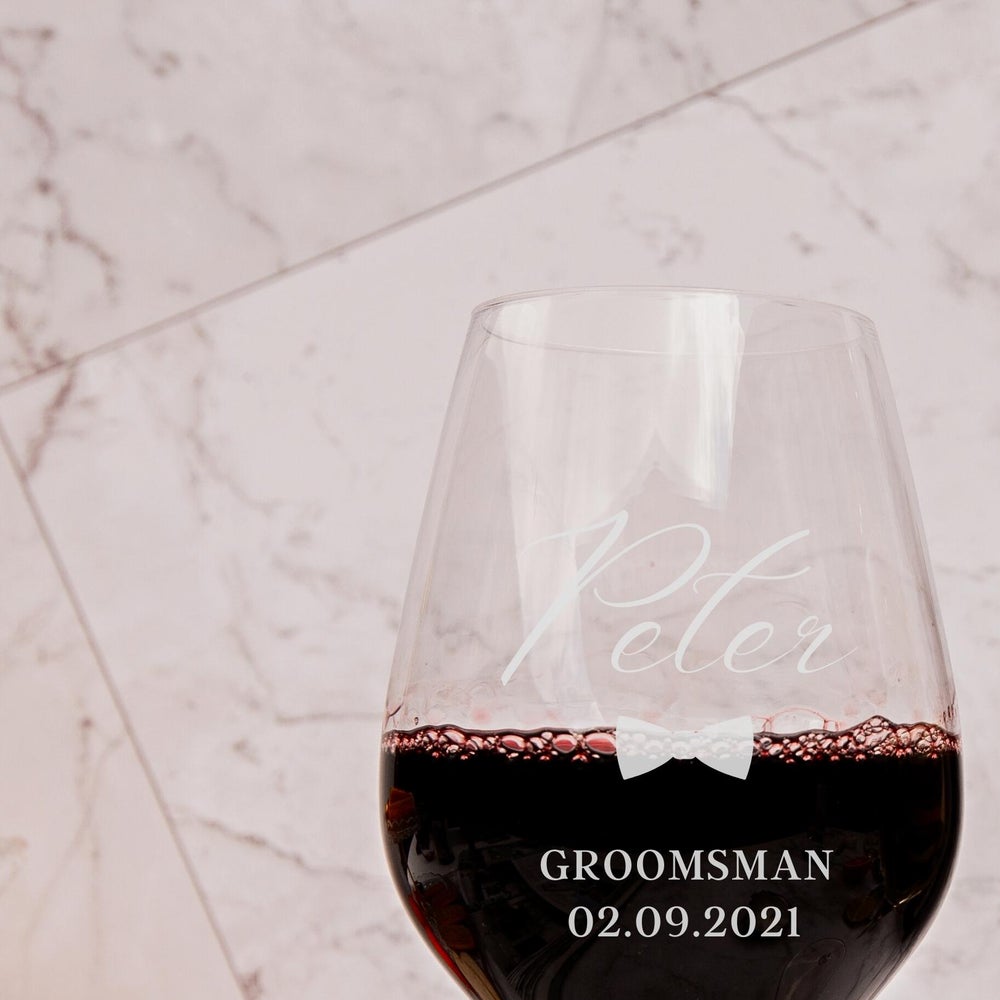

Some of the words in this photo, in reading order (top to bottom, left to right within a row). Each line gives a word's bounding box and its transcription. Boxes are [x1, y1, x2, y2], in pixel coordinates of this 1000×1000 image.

[501, 510, 856, 685] Peter
[540, 848, 833, 882] GROOMSMAN
[567, 905, 801, 939] 02.09.2021
